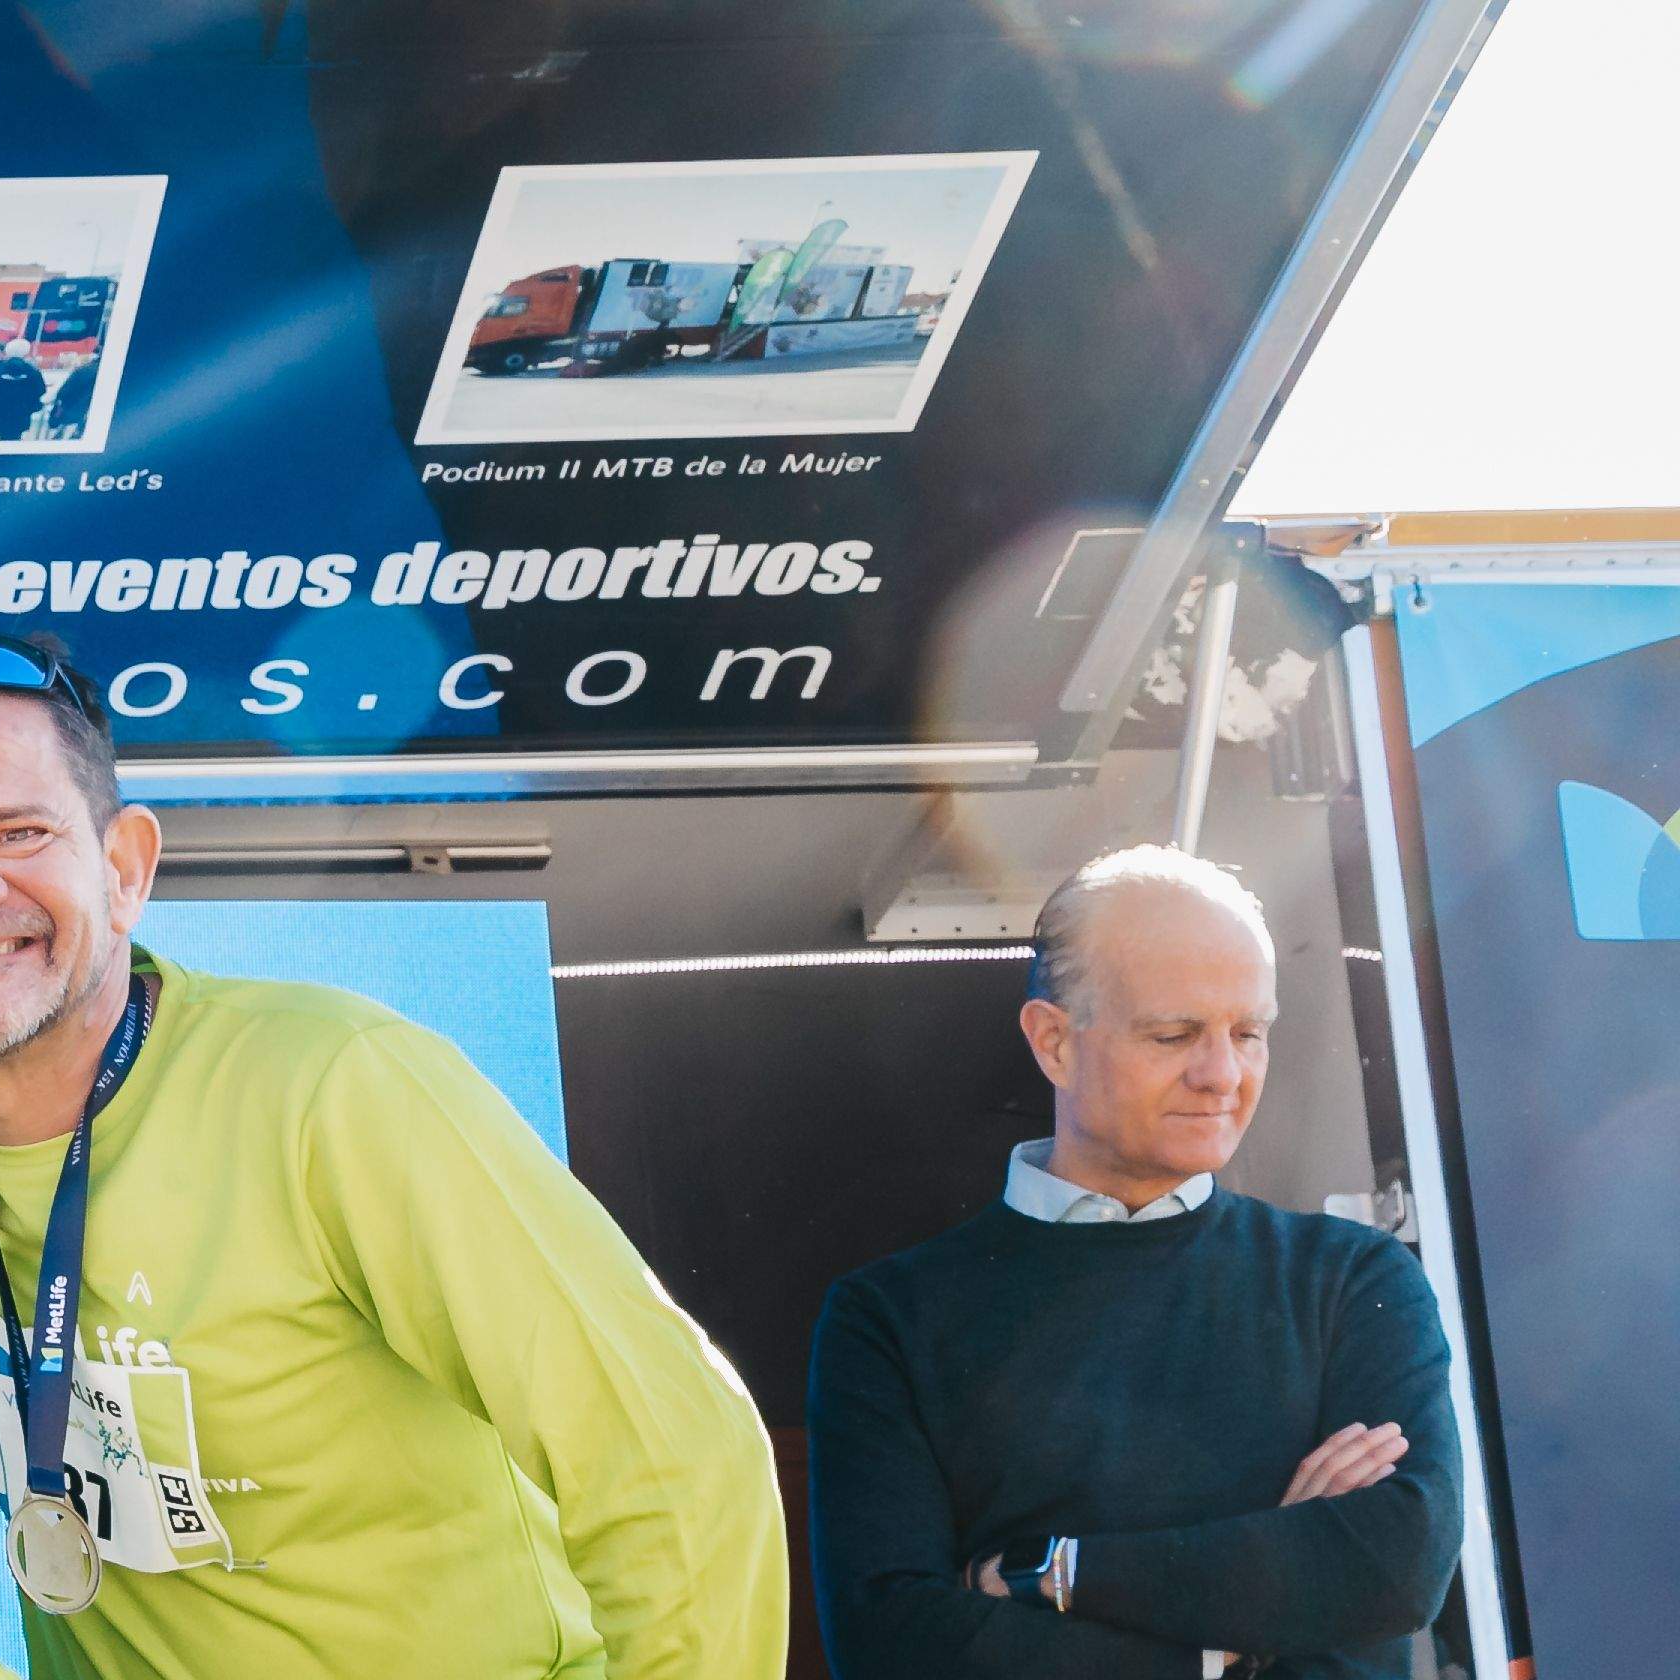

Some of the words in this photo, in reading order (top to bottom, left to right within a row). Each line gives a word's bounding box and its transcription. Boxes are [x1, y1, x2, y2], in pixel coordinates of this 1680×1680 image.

[422, 460, 546, 484] Podium
[559, 460, 580, 480] II
[593, 457, 673, 479] MTB
[684, 454, 727, 478] de
[737, 452, 767, 474] la
[778, 450, 882, 479] Mujer
[370, 533, 884, 610] deportivos.
[45, 1275, 68, 1345] MetLife
